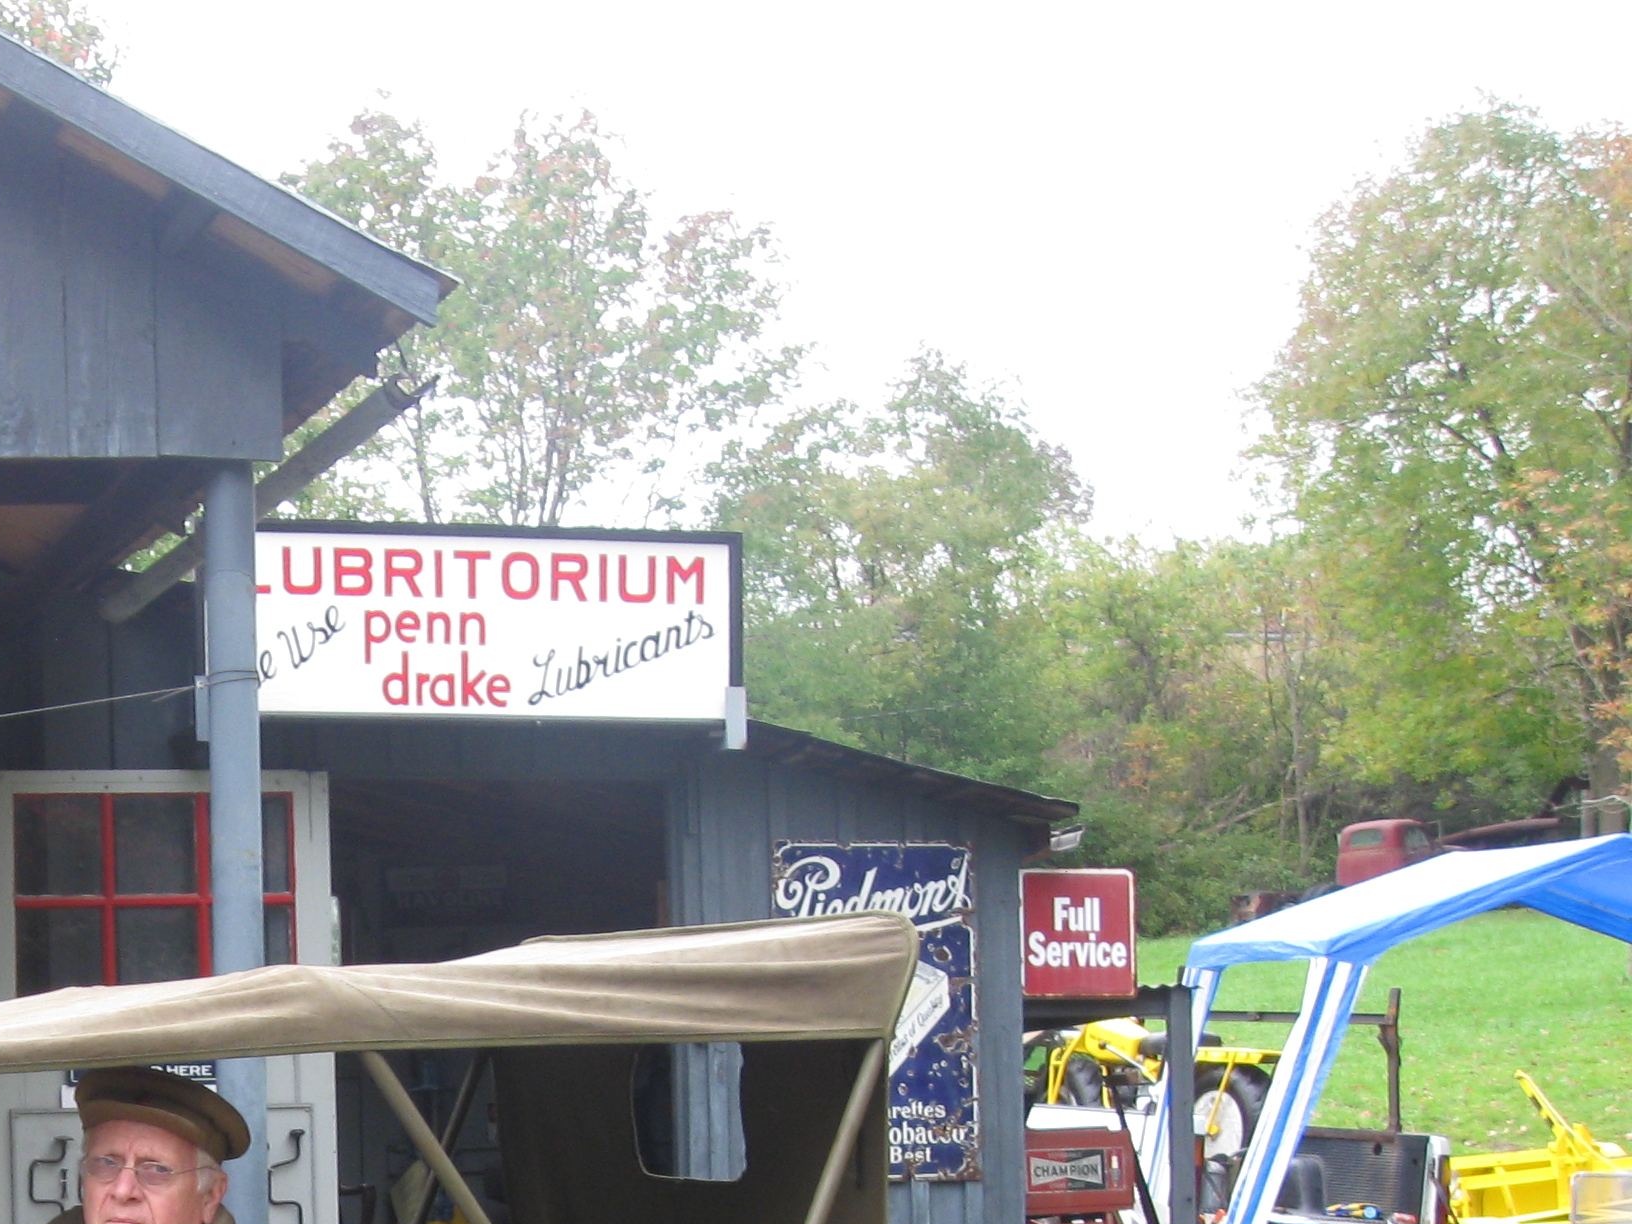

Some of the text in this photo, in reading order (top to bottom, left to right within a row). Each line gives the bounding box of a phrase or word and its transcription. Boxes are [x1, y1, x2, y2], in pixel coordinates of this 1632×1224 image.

[276, 604, 346, 670] Use
[364, 609, 486, 664] penn
[527, 610, 718, 706] Lubricants
[382, 651, 512, 708] drake
[775, 853, 972, 919] Piedmont
[1053, 896, 1101, 932] Full
[1028, 931, 1128, 968] Service
[167, 1064, 213, 1077] HERE
[888, 1121, 965, 1145] obacco
[889, 1146, 932, 1164] Best
[1034, 1164, 1099, 1178] CHAMPION
